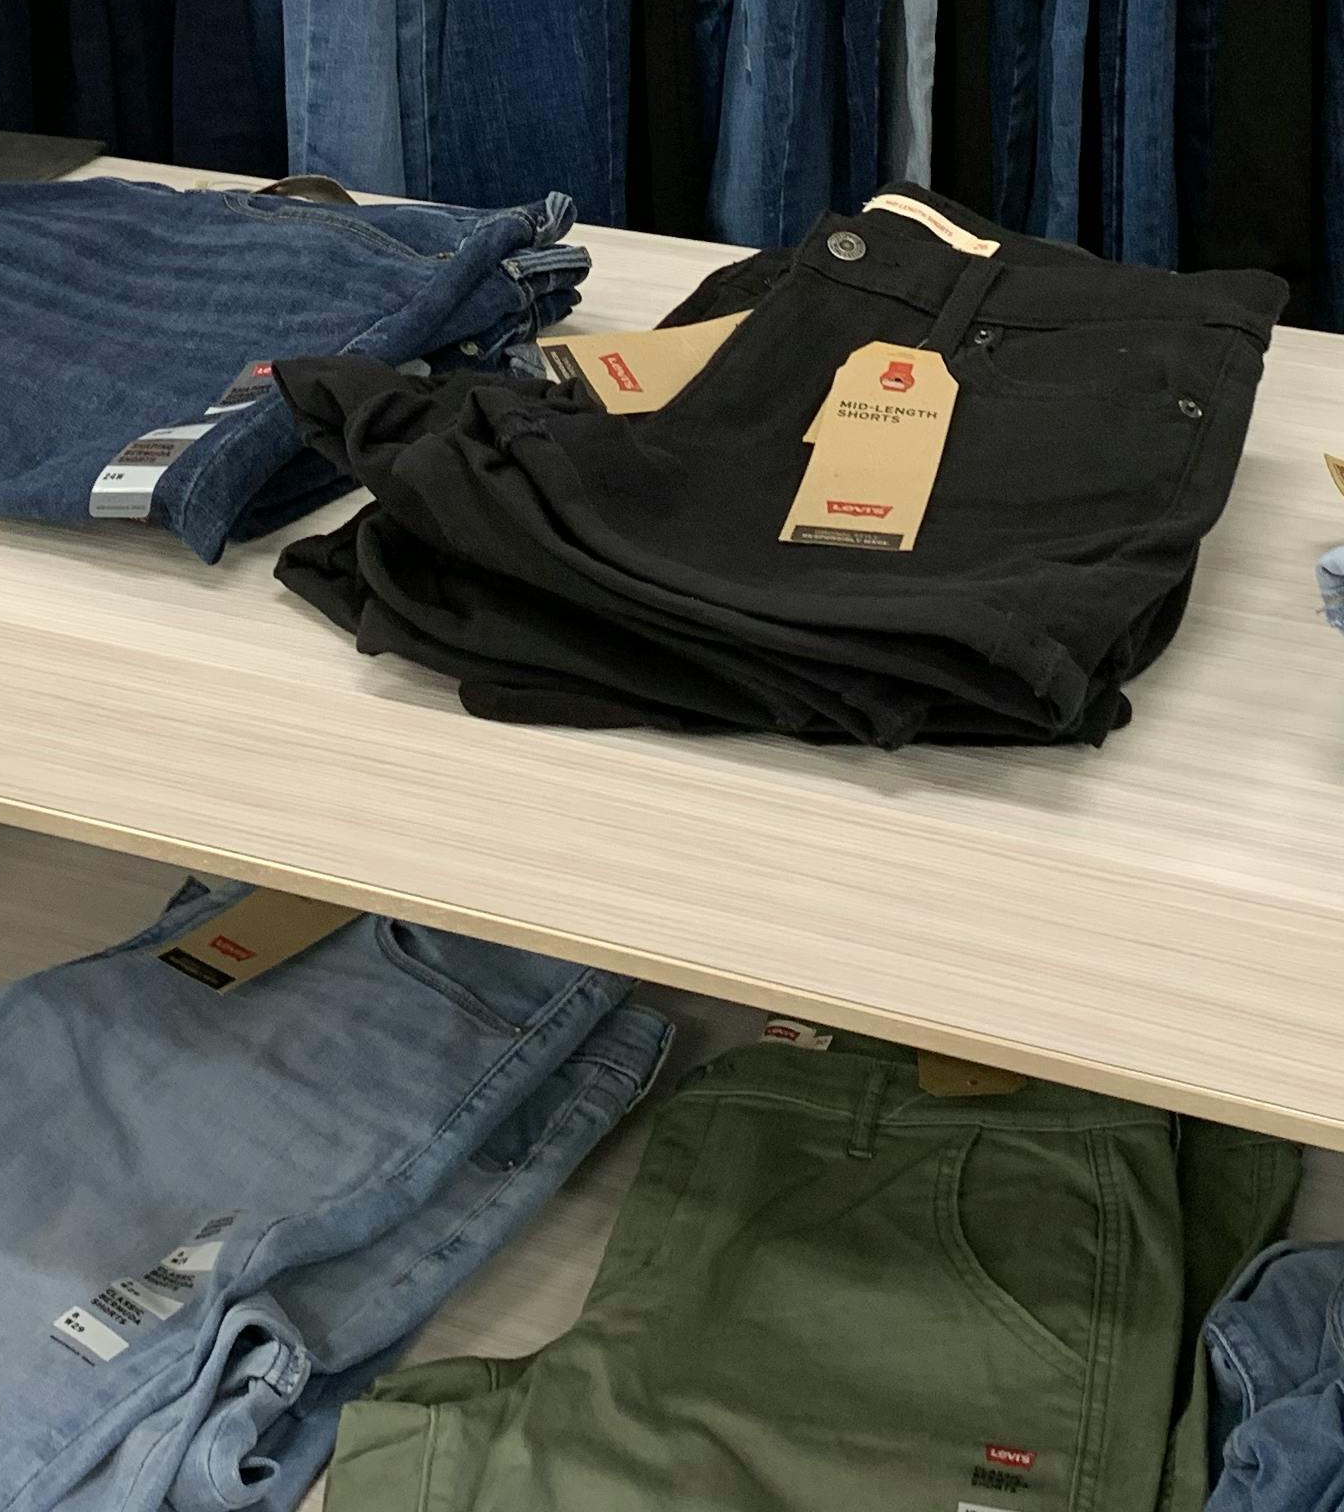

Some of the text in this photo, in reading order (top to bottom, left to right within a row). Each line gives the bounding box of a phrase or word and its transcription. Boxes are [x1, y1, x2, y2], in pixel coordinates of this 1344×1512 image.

[837, 409, 900, 424] SHORTS
[840, 400, 937, 420] MID-LENGTH
[90, 1297, 127, 1326] SHORTS
[98, 1293, 141, 1326] BERMUDA
[106, 1288, 145, 1316] CLASSIC
